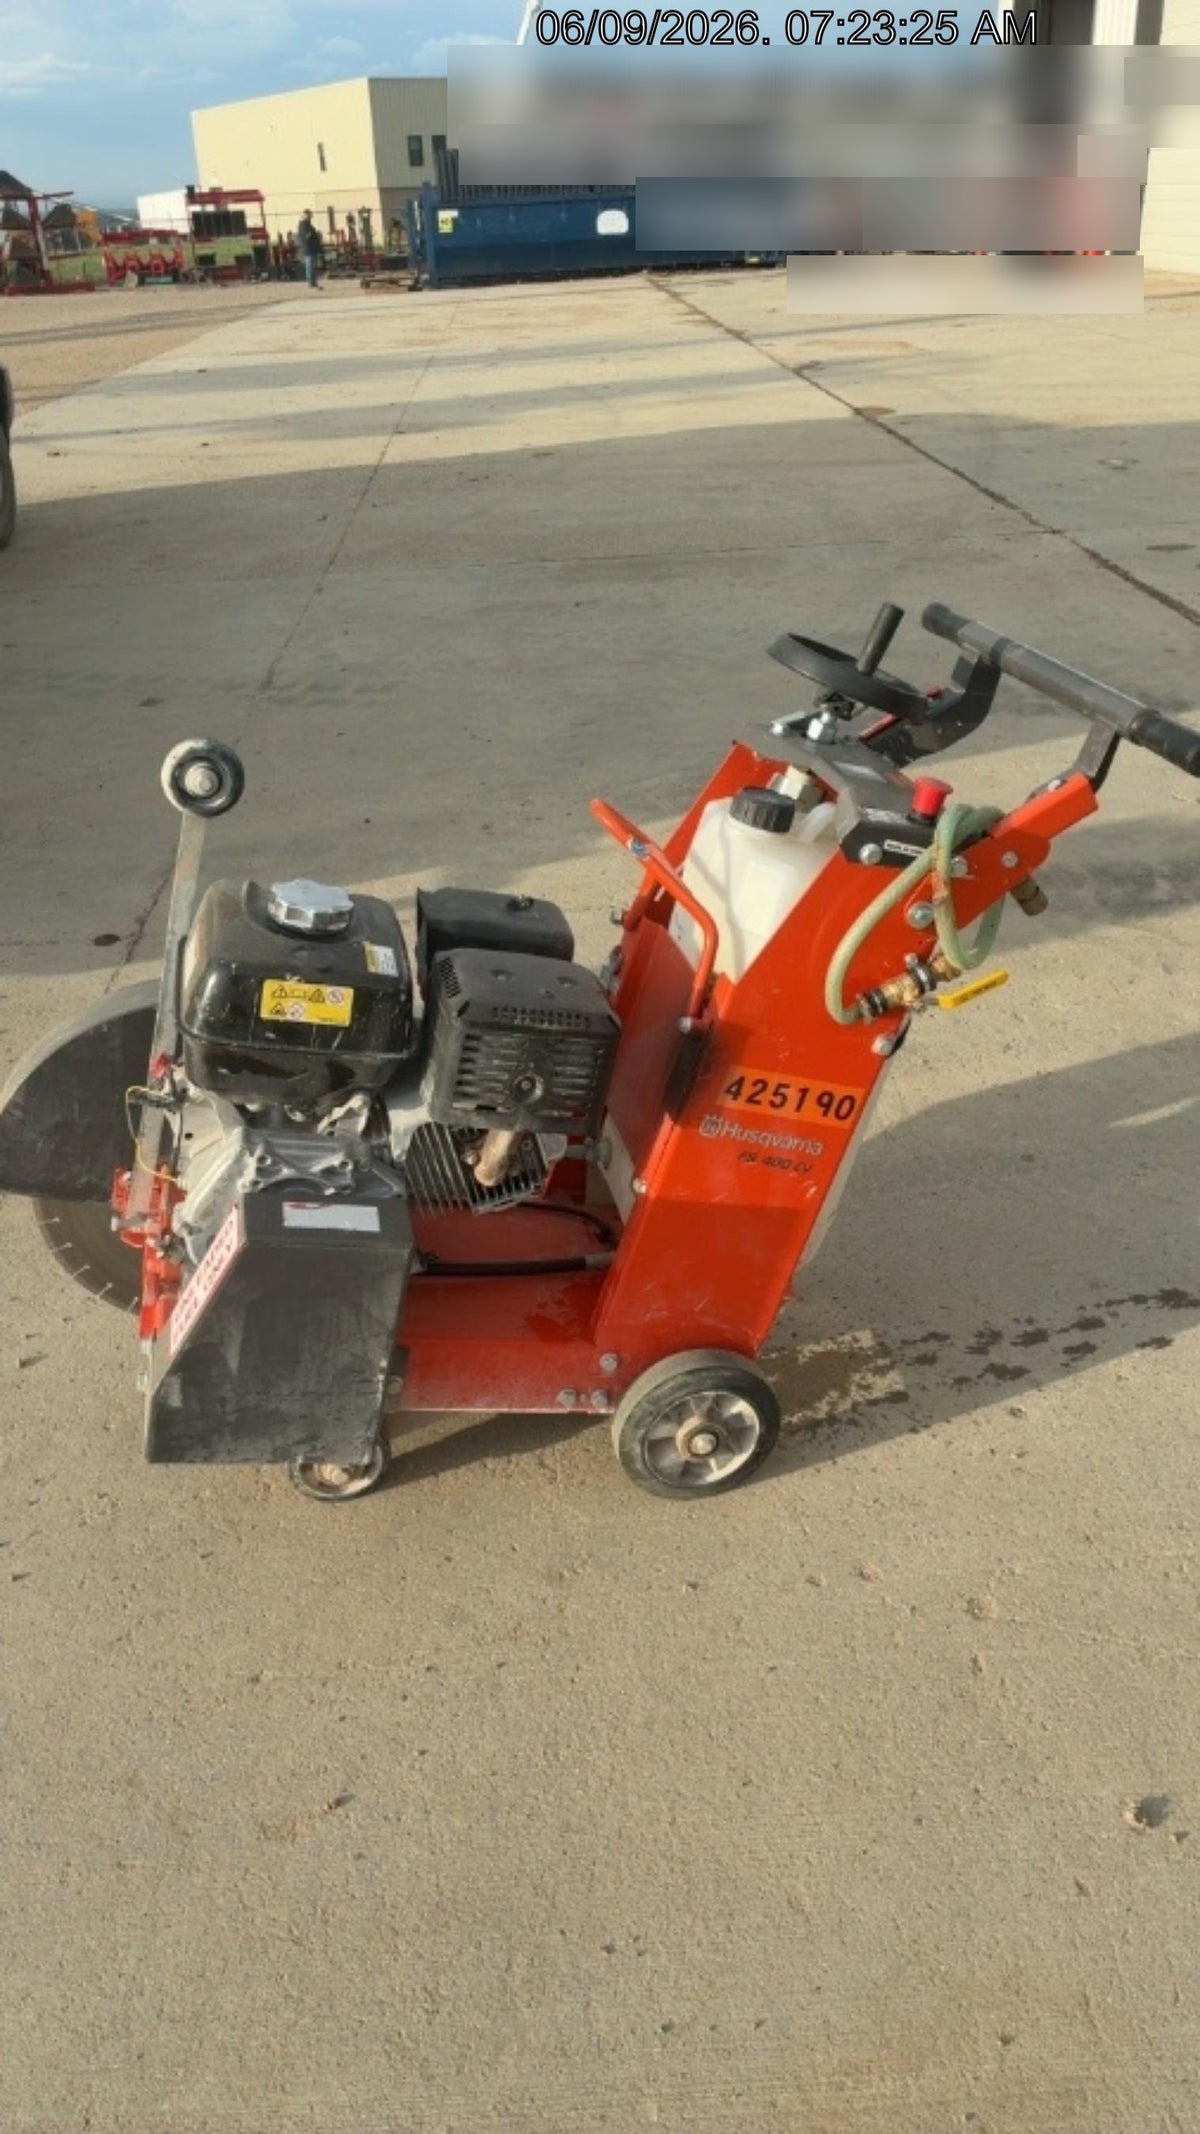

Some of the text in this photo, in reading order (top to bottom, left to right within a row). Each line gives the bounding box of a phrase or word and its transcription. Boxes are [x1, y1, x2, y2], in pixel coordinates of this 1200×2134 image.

[724, 1076, 855, 1120] 425190
[721, 1120, 823, 1156] Husqvarna
[761, 1156, 792, 1170] 400
